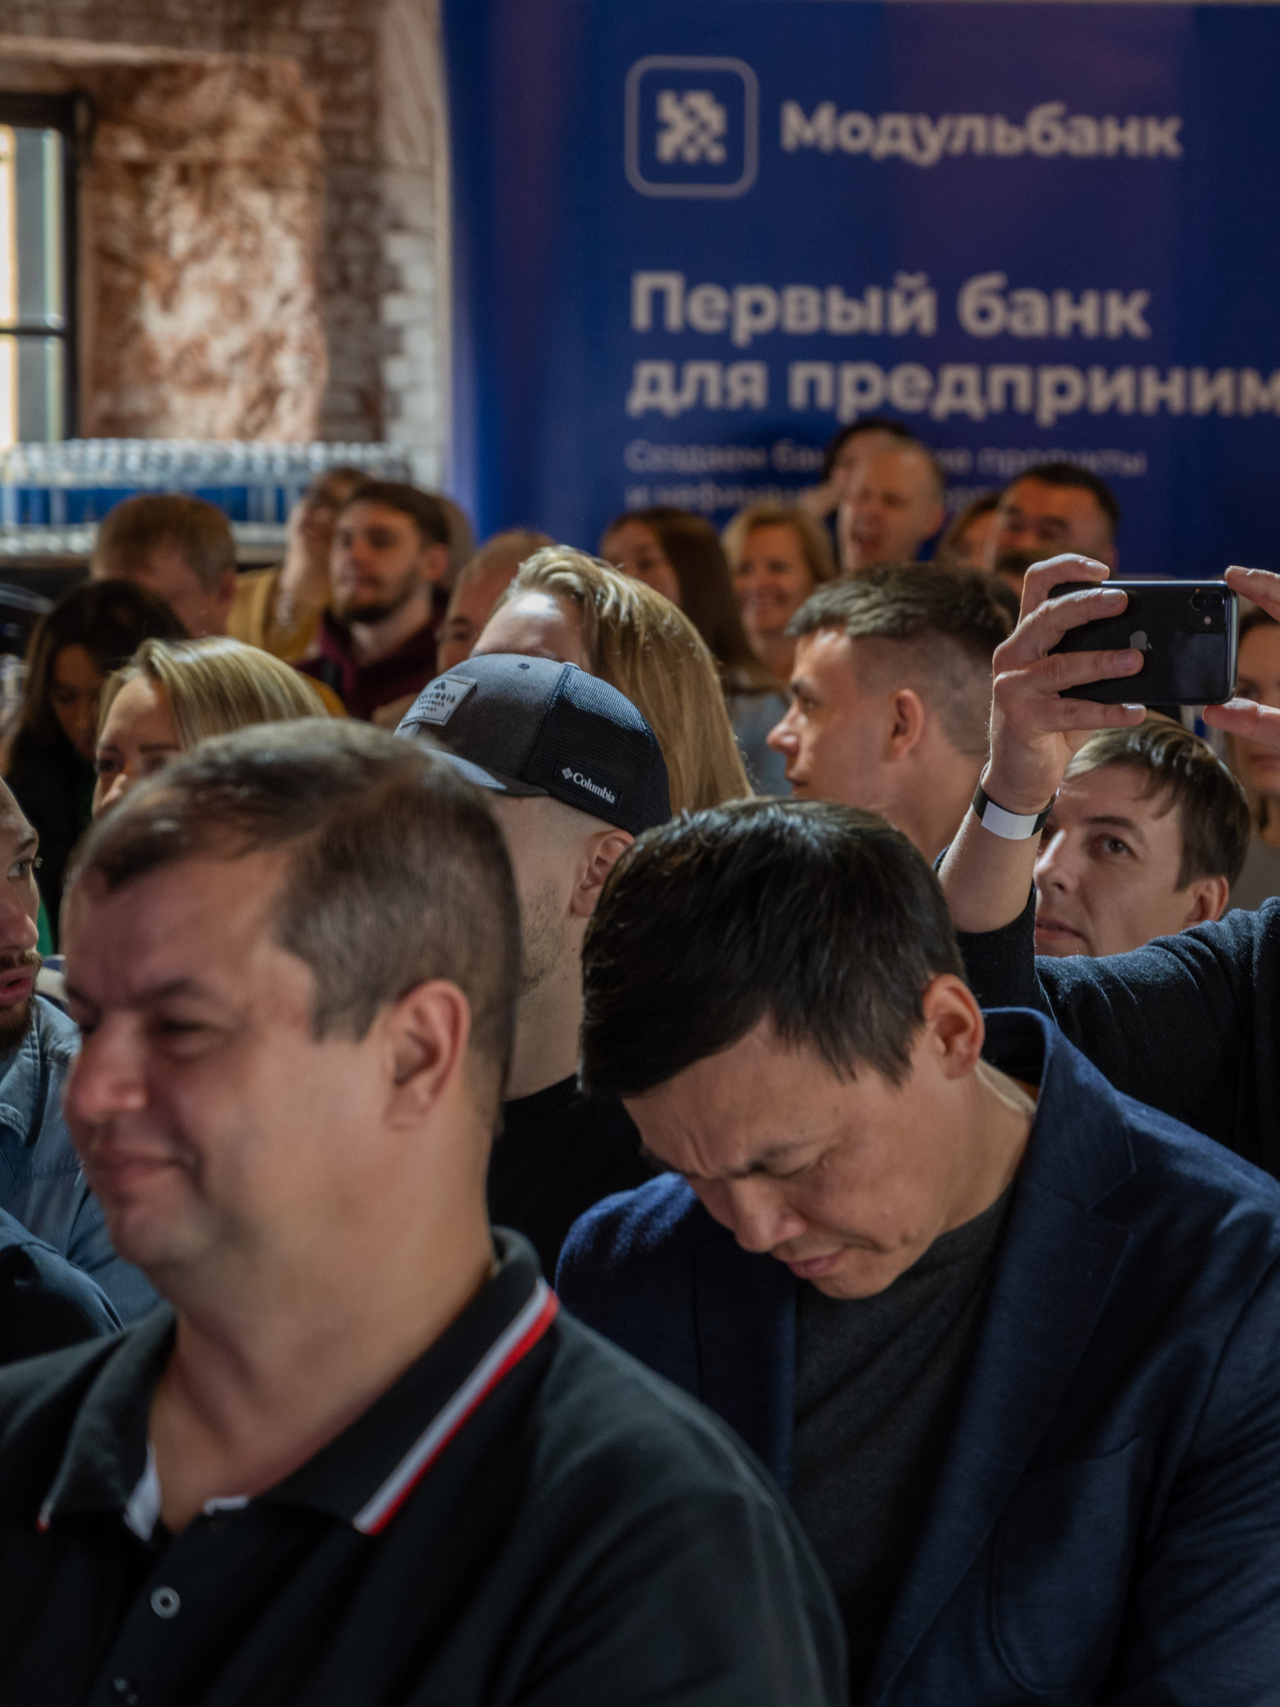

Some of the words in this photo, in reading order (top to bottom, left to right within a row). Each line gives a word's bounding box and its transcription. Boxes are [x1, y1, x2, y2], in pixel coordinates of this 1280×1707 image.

[781, 101, 1183, 166] Модульбанк
[631, 271, 937, 346] Первый
[957, 271, 1151, 339] банк
[626, 360, 768, 418] для
[573, 772, 615, 804] Columbia
